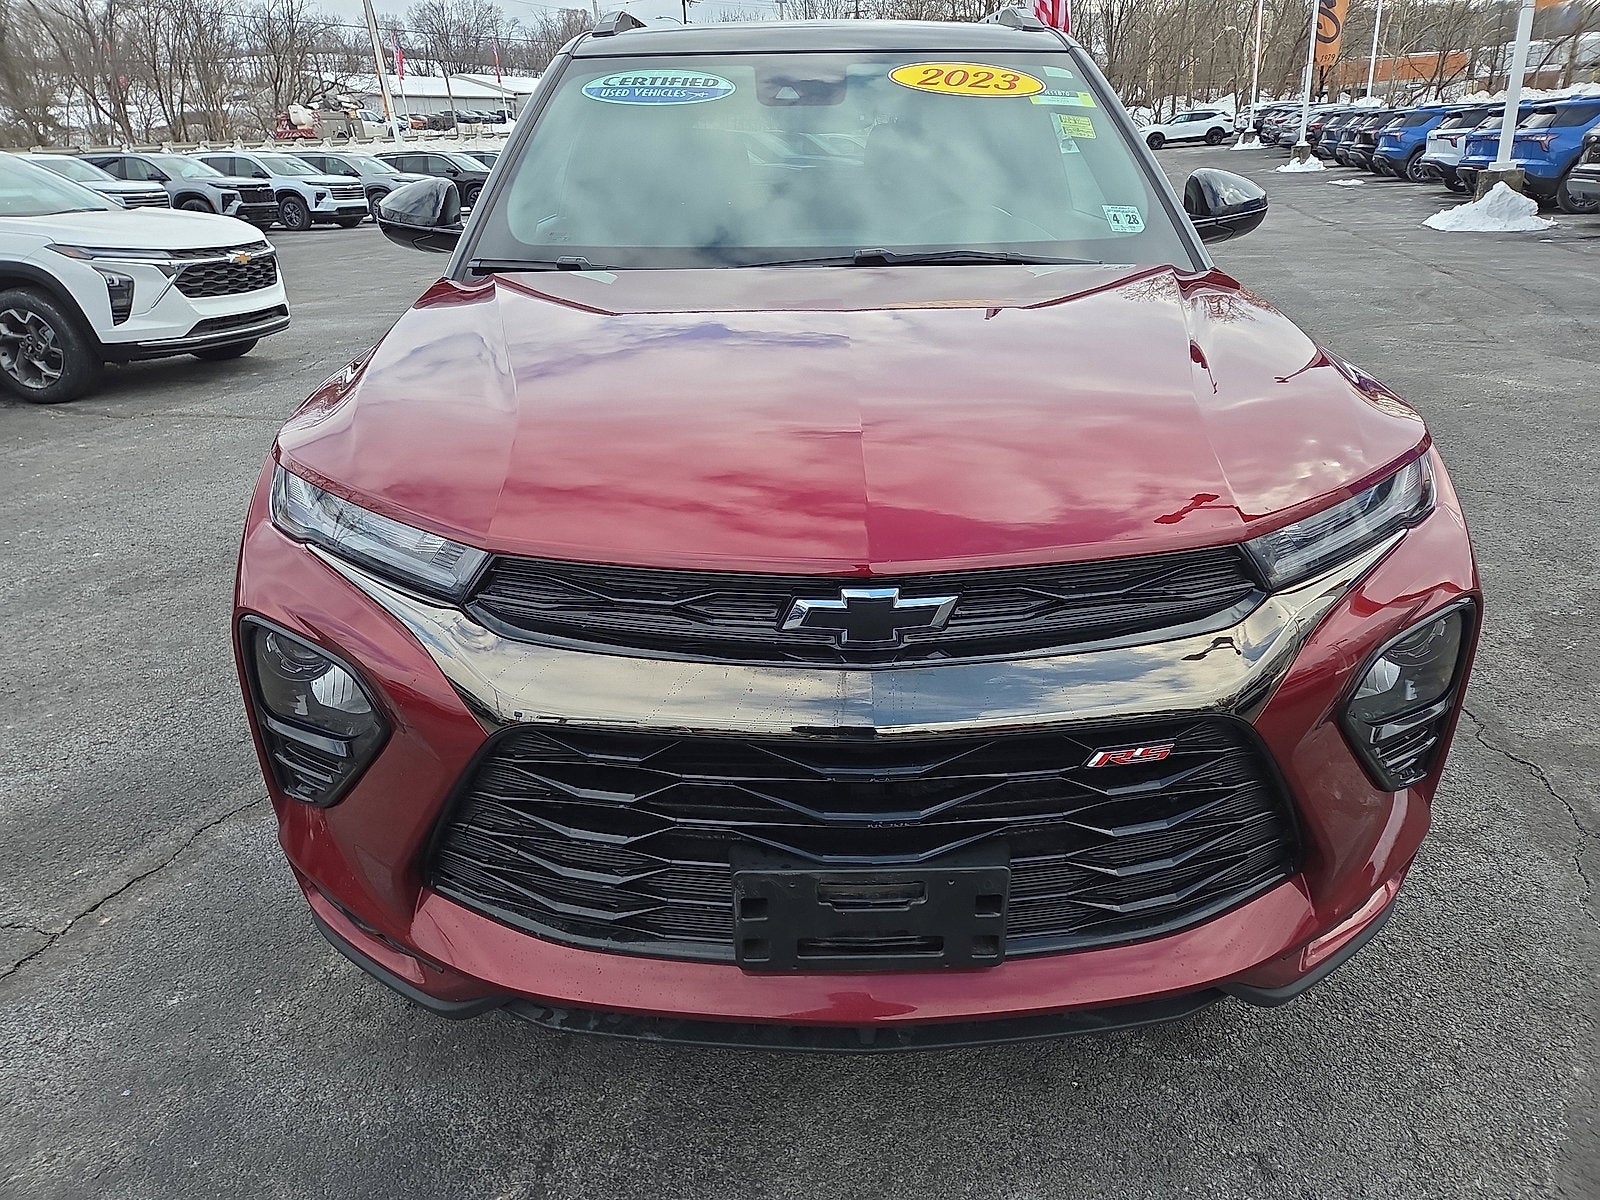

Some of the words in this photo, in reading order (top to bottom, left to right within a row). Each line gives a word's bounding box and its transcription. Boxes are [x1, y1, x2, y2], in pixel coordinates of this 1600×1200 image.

[602, 76, 720, 88] CERTIFIED
[916, 67, 1020, 91] 2023
[601, 88, 630, 98] USED
[634, 87, 687, 98] VEHICLES
[1112, 213, 1120, 224] 4
[1126, 214, 1139, 225] 28
[1086, 743, 1175, 768] RS
